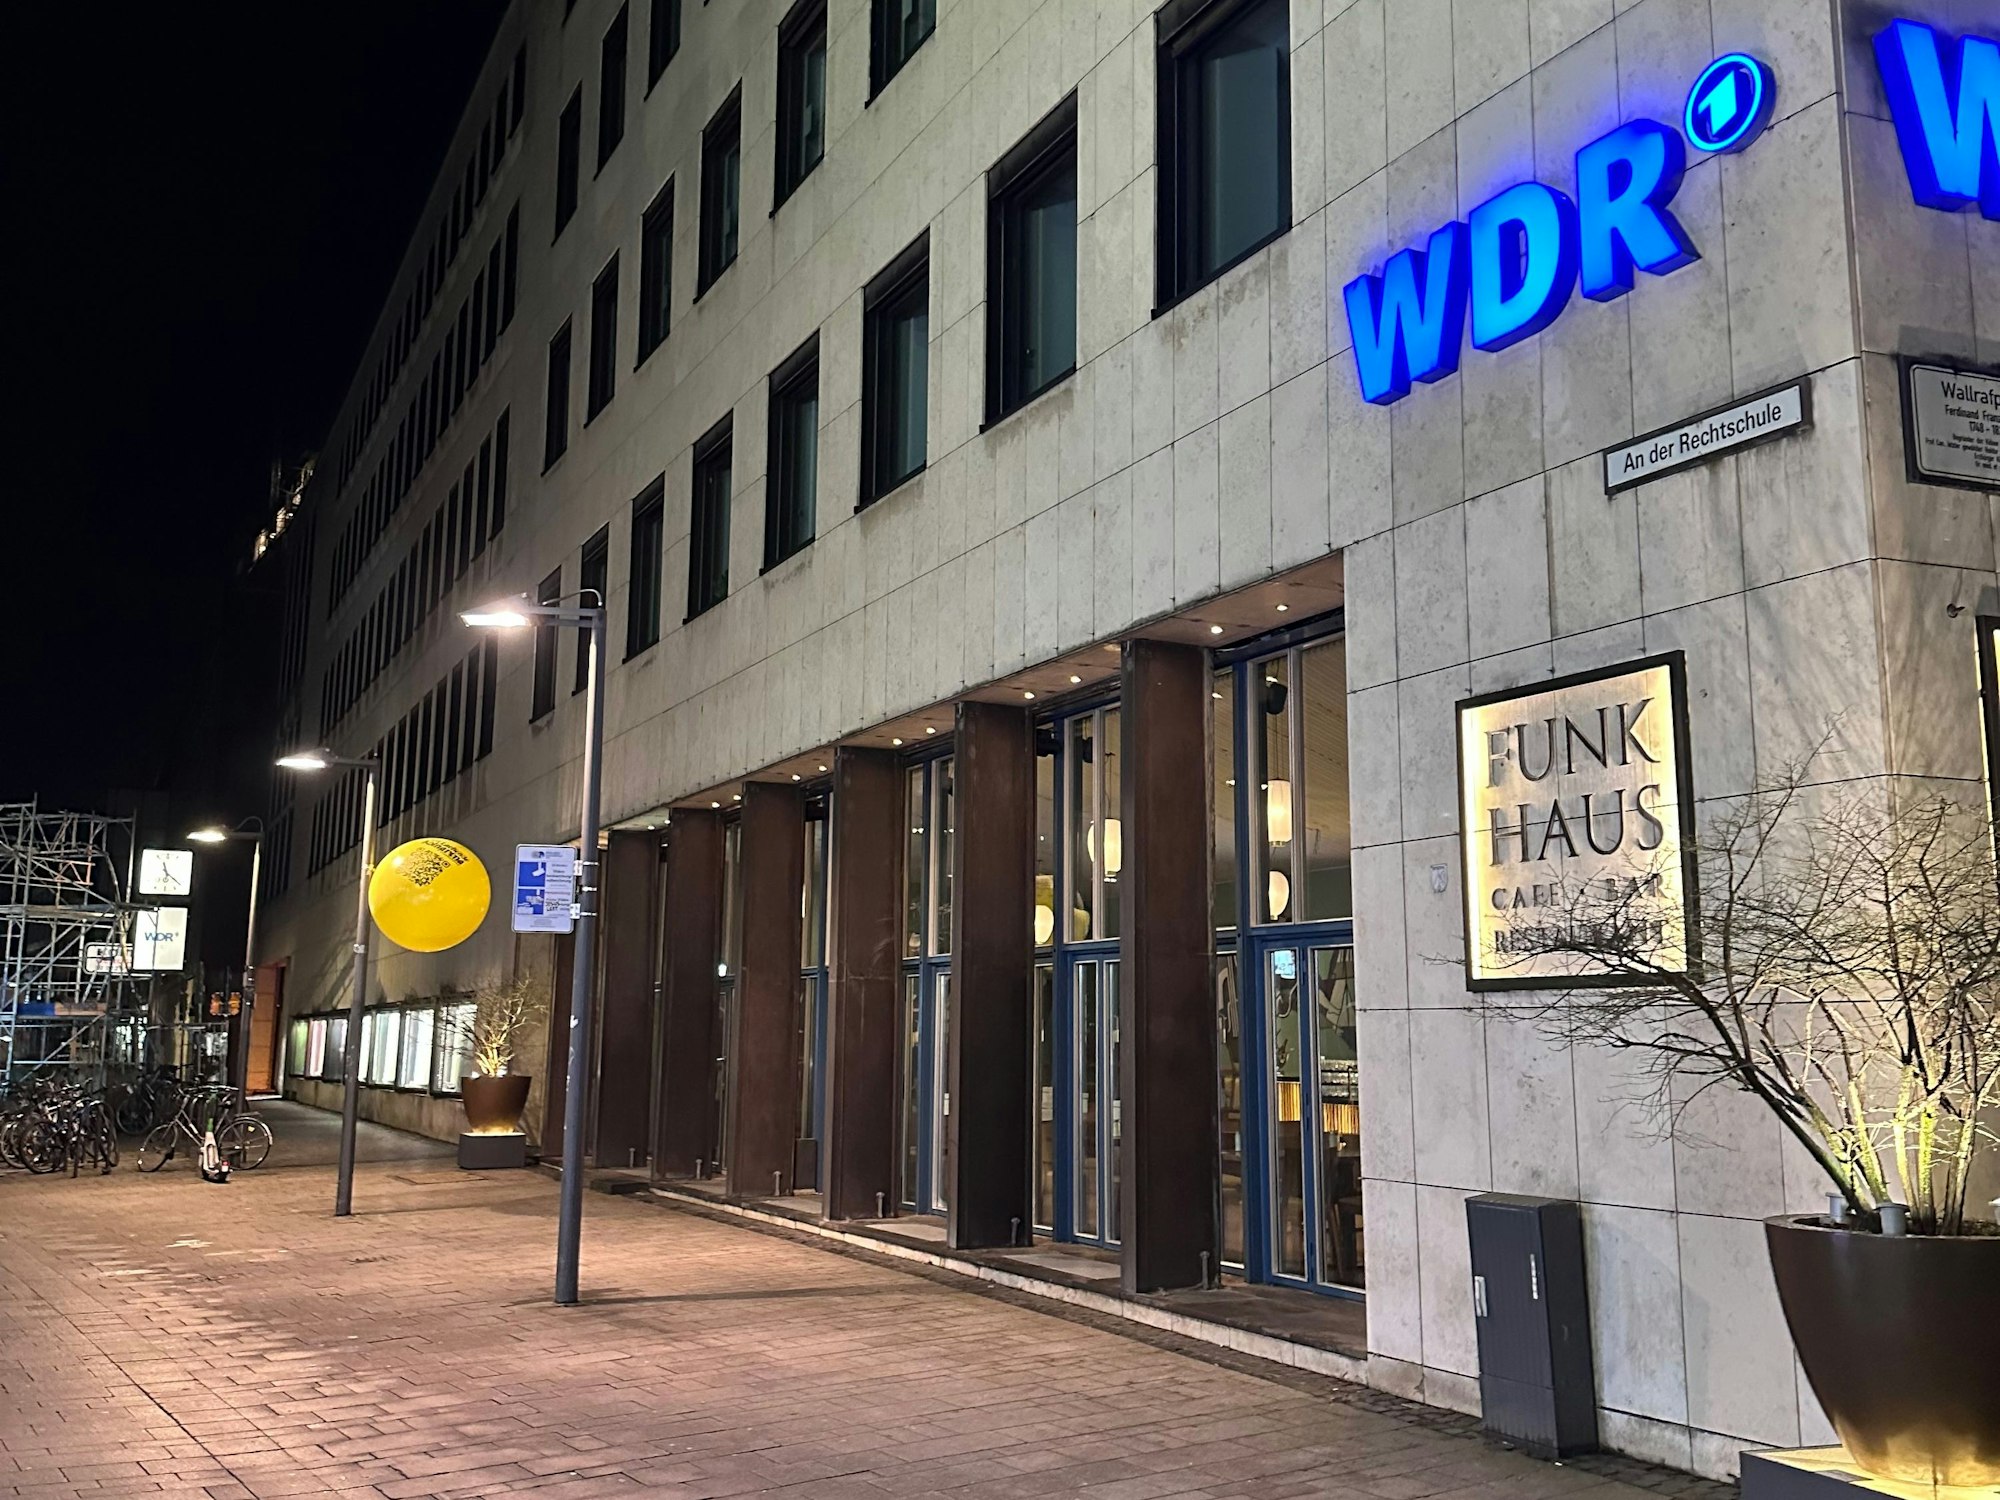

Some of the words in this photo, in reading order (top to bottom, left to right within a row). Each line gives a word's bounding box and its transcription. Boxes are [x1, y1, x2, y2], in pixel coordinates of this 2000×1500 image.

[1343, 118, 1702, 405] WDR
[1623, 451, 1645, 474] An
[1649, 441, 1675, 464] der
[1679, 402, 1783, 454] Rechtschule
[1485, 697, 1661, 788] FUNK
[1487, 784, 1665, 866] HAUS
[1606, 873, 1670, 902] BAR
[144, 932, 173, 942] WDR
